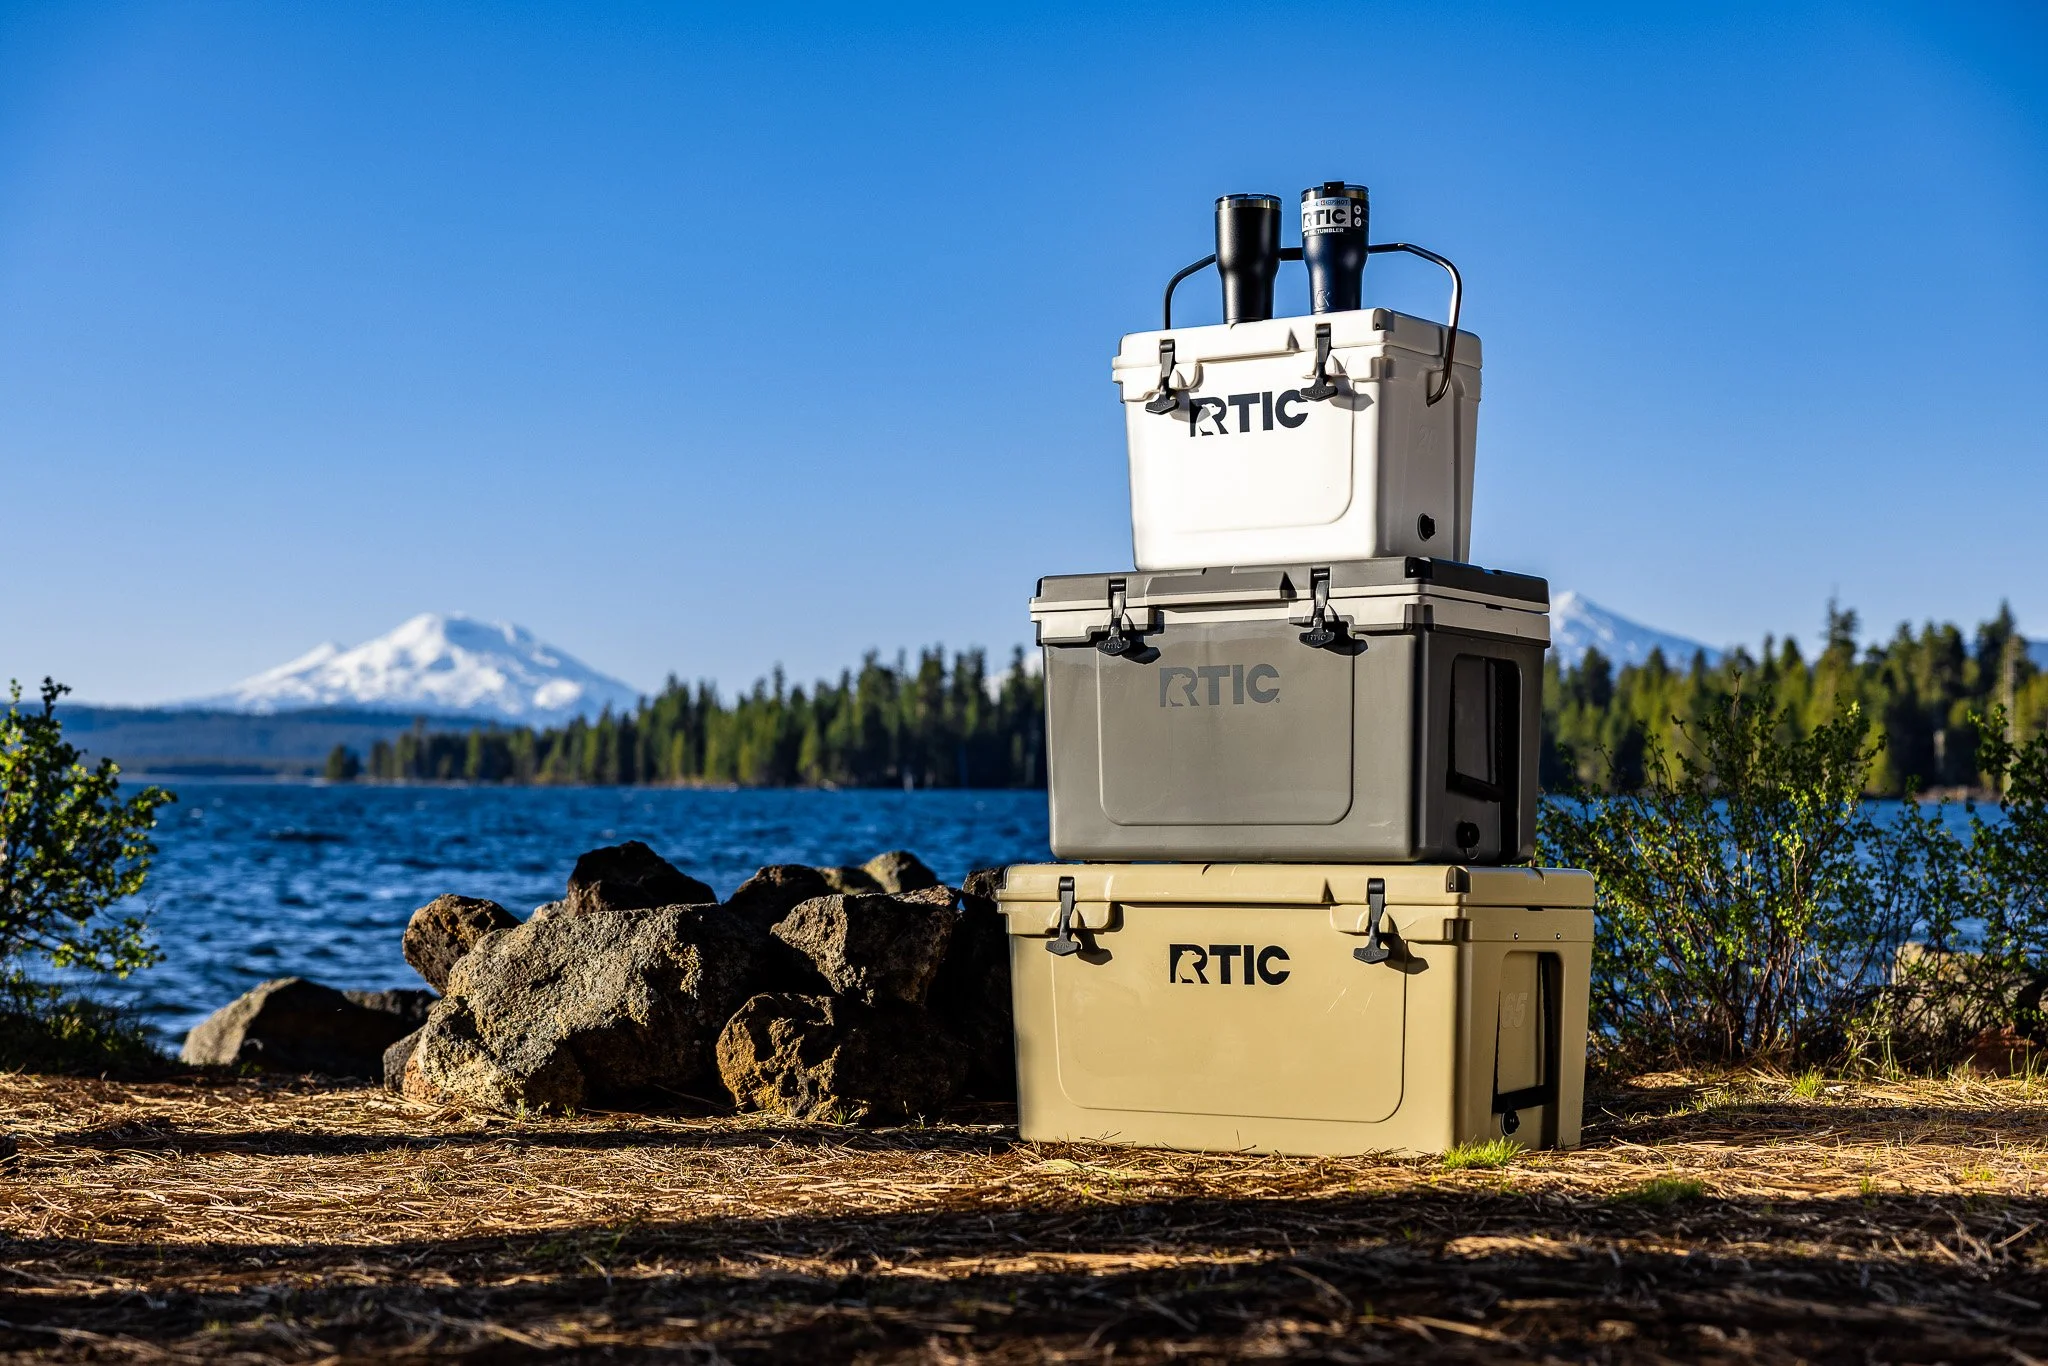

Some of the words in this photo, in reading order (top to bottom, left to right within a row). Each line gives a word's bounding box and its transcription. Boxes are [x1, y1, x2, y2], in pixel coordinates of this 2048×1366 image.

[1302, 208, 1347, 229] RTIC
[1189, 389, 1308, 437] RTIC
[1159, 663, 1280, 707] RTIC
[1169, 943, 1291, 986] RTIC
